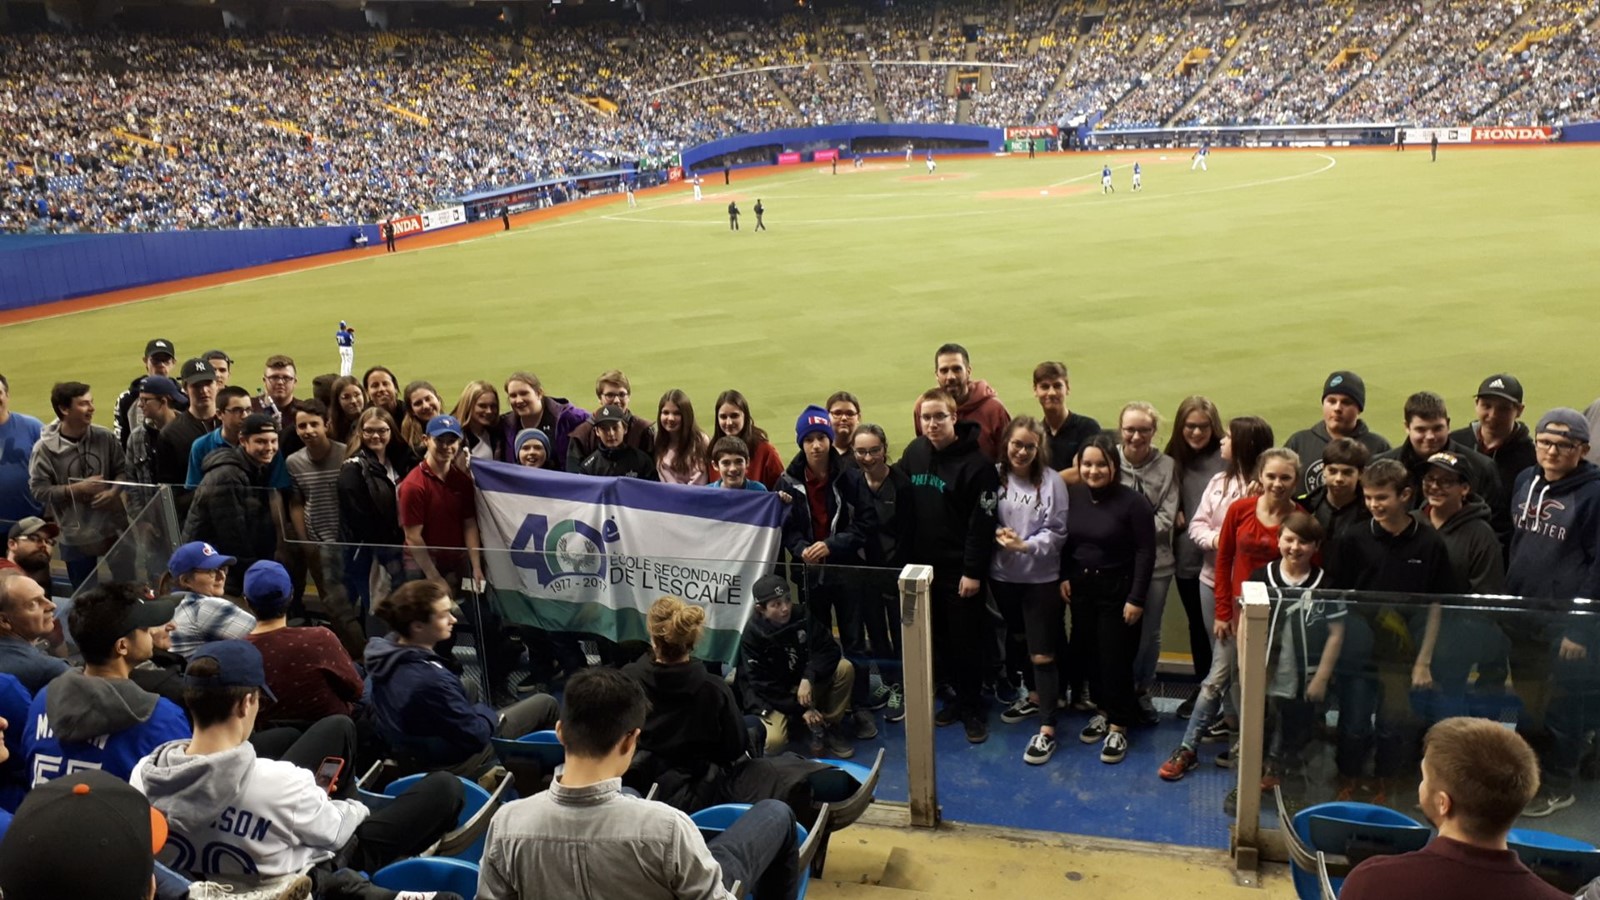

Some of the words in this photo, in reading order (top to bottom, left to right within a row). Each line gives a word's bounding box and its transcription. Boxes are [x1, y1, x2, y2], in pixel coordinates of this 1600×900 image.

[1475, 129, 1547, 140] HONDA
[653, 562, 742, 587] SECONDAIRE
[550, 578, 571, 593] 1977
[610, 567, 635, 587] DE
[642, 571, 742, 605] L'ESCALE
